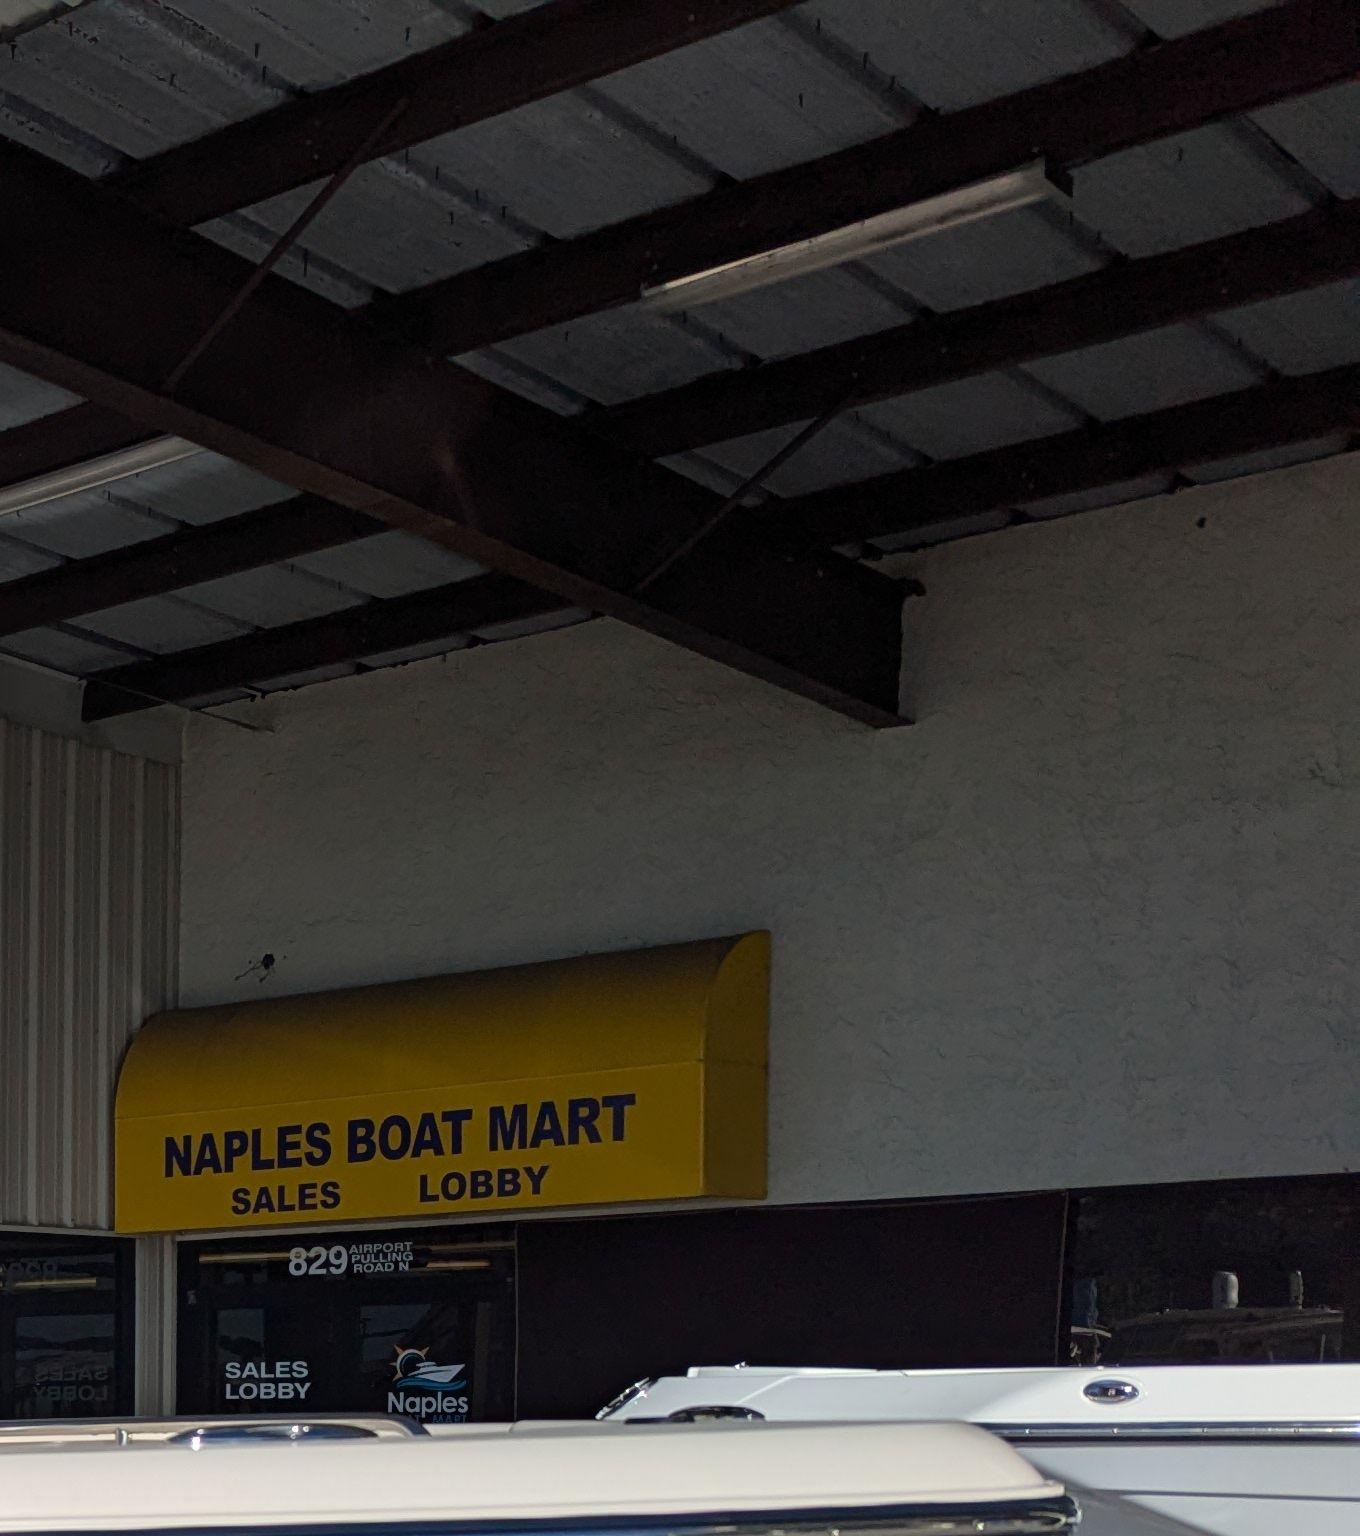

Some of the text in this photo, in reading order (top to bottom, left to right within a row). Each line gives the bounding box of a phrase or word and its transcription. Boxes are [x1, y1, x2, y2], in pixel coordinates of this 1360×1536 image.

[164, 1092, 637, 1179] NAPLES BOAT MART
[231, 1164, 550, 1216] SALES LOBBY
[288, 1241, 414, 1277] 829 AIRPORT
[351, 1251, 414, 1264] PULLING
[353, 1261, 410, 1274] ROAD N
[224, 1360, 309, 1380] SALES
[224, 1381, 312, 1401] LOBBY
[387, 1391, 469, 1418] Naples
